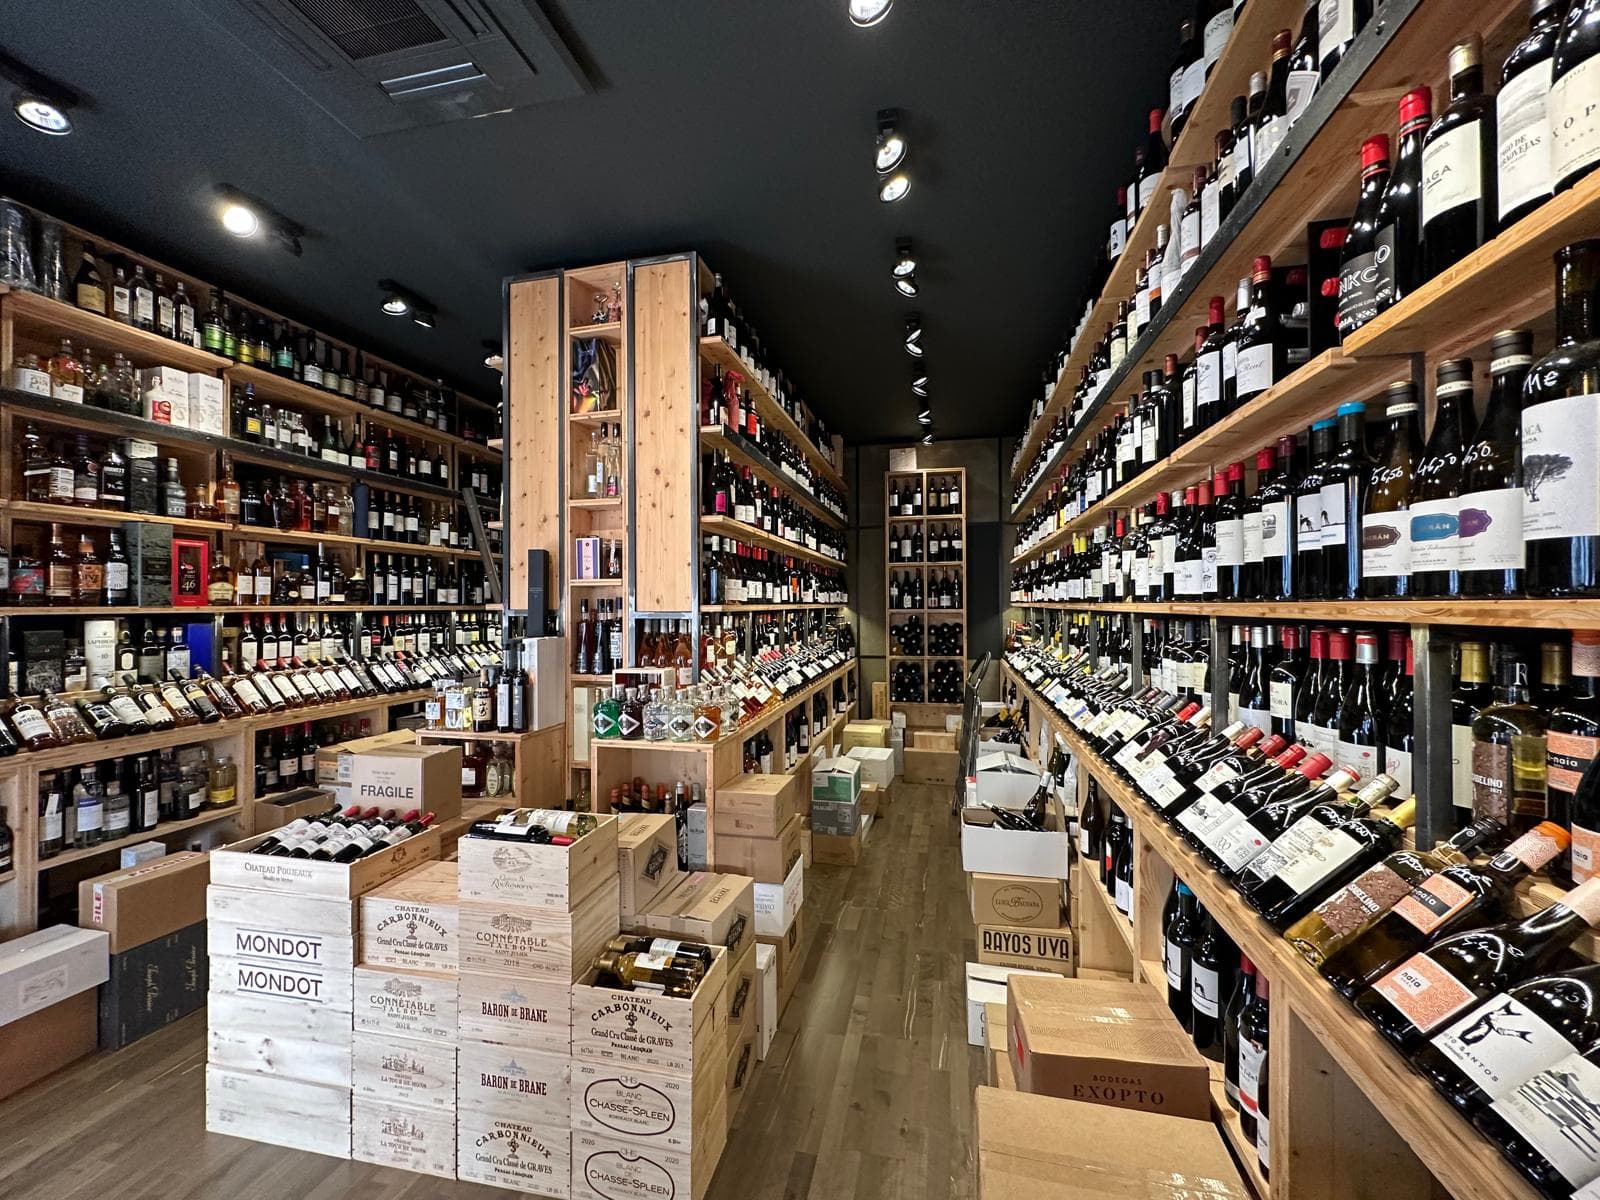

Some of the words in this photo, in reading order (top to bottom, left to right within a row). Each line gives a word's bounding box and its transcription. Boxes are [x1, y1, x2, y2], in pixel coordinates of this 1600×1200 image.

[361, 784, 414, 799] FRAGILE
[244, 861, 276, 874] CHATEAU
[277, 865, 313, 879] POUJEAUX
[394, 905, 430, 914] CHATEAU
[377, 912, 447, 938] CARBONNIEUX
[236, 933, 322, 960] MONDOT
[377, 936, 392, 946] Grand
[392, 938, 402, 947] Cru
[418, 942, 424, 950] de
[424, 942, 448, 952] GRAVES
[476, 932, 548, 948] CONNÉTABLE
[490, 942, 534, 952] TALBOT
[983, 931, 1031, 955] RAYOS
[1037, 936, 1069, 959] UVA
[503, 959, 520, 967] 2018
[238, 969, 323, 997] MONDOT
[1401, 970, 1422, 989] naia
[370, 995, 437, 1012] CONNÉTABLE
[611, 994, 652, 1005] CHATEAU
[383, 1006, 424, 1016] TALBOT
[482, 1002, 509, 1018] BARON
[511, 1008, 518, 1016] DE
[520, 1007, 547, 1023] BRANE
[591, 1003, 673, 1032] CARBONNIEUX
[394, 1021, 411, 1030] 2018
[591, 1027, 608, 1038] Grand
[609, 1030, 620, 1040] Cru
[639, 1034, 645, 1044] de
[646, 1036, 674, 1048] GRAVES
[620, 1053, 639, 1061] BLANC
[481, 1073, 509, 1090] BARON
[511, 1080, 517, 1089] DE
[519, 1079, 546, 1096] BRANE
[1093, 1074, 1142, 1086] BODEGAS
[616, 1090, 642, 1101] BLANC
[1073, 1084, 1164, 1106] EXOPTO
[589, 1098, 670, 1122] CHASSE-SPLEEN
[494, 1121, 532, 1132] CHATEAU
[475, 1129, 552, 1159] CARBONNIEUX
[581, 1138, 595, 1146] 2020
[475, 1152, 492, 1164] Grand
[492, 1155, 502, 1166] Cru
[519, 1160, 527, 1170] de
[527, 1161, 553, 1175] GRAVES
[589, 1169, 670, 1196] CHASSE-SPLEEN
